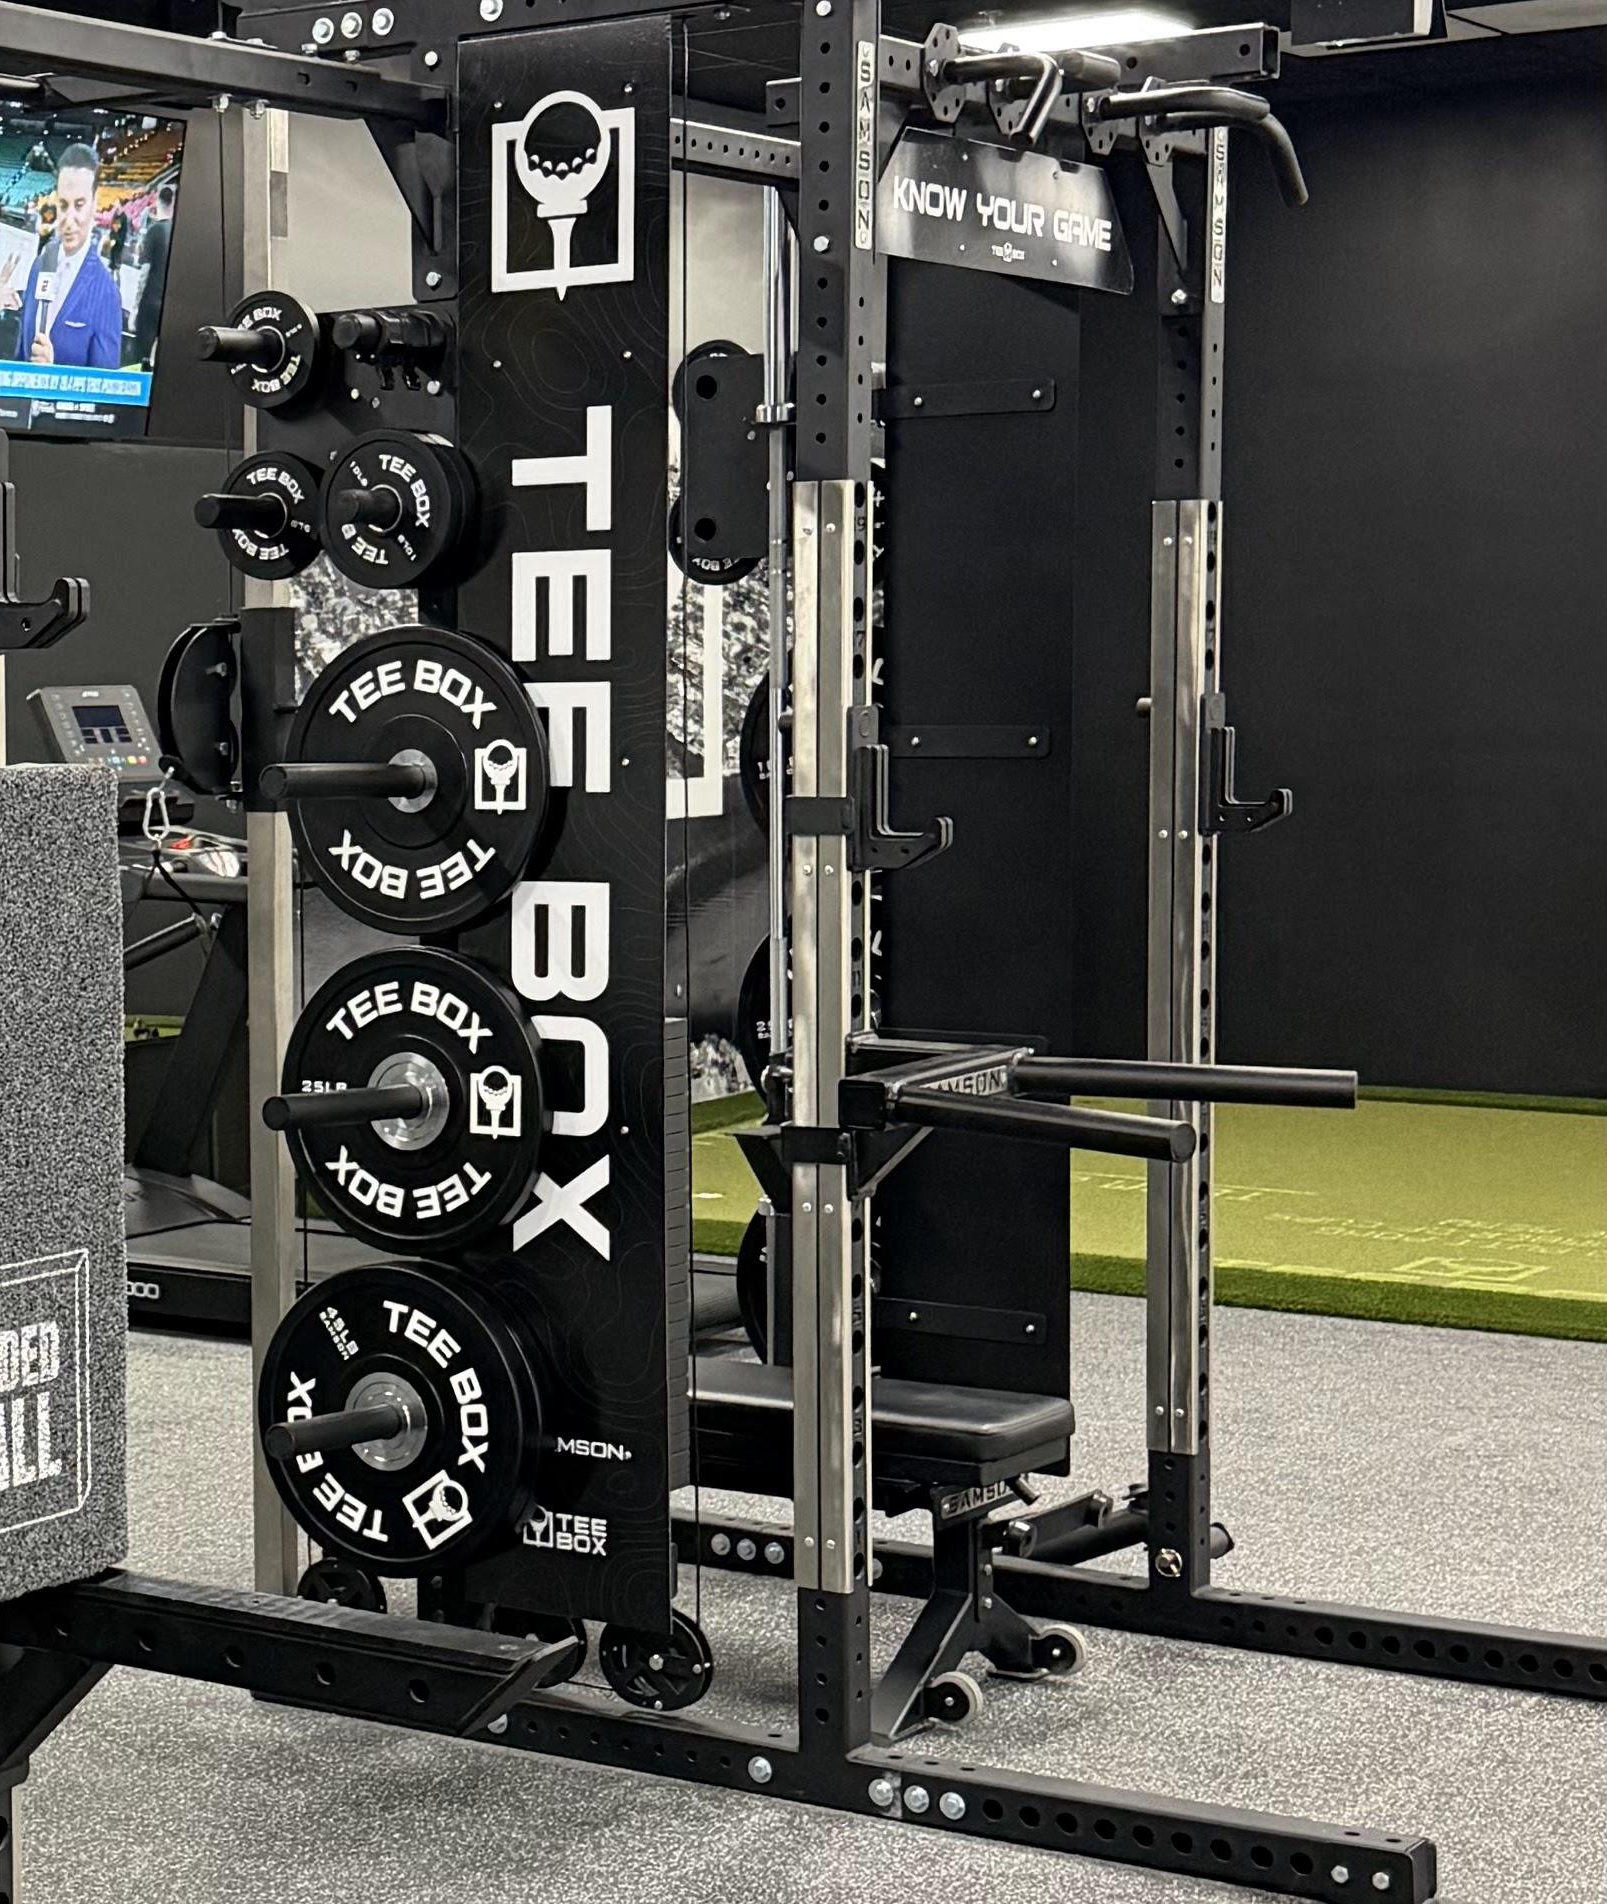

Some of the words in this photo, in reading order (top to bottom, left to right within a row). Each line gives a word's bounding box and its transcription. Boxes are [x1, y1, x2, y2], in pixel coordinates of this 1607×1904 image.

[857, 62, 874, 231] SAMSON
[893, 176, 967, 221] KNOW
[976, 192, 1045, 237] YOUR
[1053, 210, 1112, 252] GAME
[254, 306, 283, 322] BOX
[251, 378, 281, 393] BOX
[280, 354, 302, 386] TEE
[245, 467, 278, 486] TEE
[277, 470, 306, 505] BOX
[378, 454, 417, 481] TEE
[410, 479, 434, 529] BOX
[232, 527, 258, 557] BOX
[257, 543, 291, 561] TEE
[351, 537, 389, 566] TEE
[511, 404, 612, 793] TEE
[328, 660, 407, 723] TEE
[413, 659, 497, 730] BOX
[327, 828, 409, 900] BOX
[416, 838, 497, 900] TEE
[325, 980, 403, 1041] TEE
[410, 980, 494, 1055] BOX
[511, 881, 611, 1262] BOX
[325, 1144, 405, 1218] BOX
[413, 1161, 493, 1220] TEE
[326, 1306, 360, 1356] 45LB
[382, 1300, 462, 1369] TEE
[449, 1367, 489, 1474] BOX
[556, 1436, 624, 1461] MSON
[312, 1472, 389, 1543] TEE
[555, 1513, 608, 1537] TEE
[555, 1531, 607, 1556] BOX
